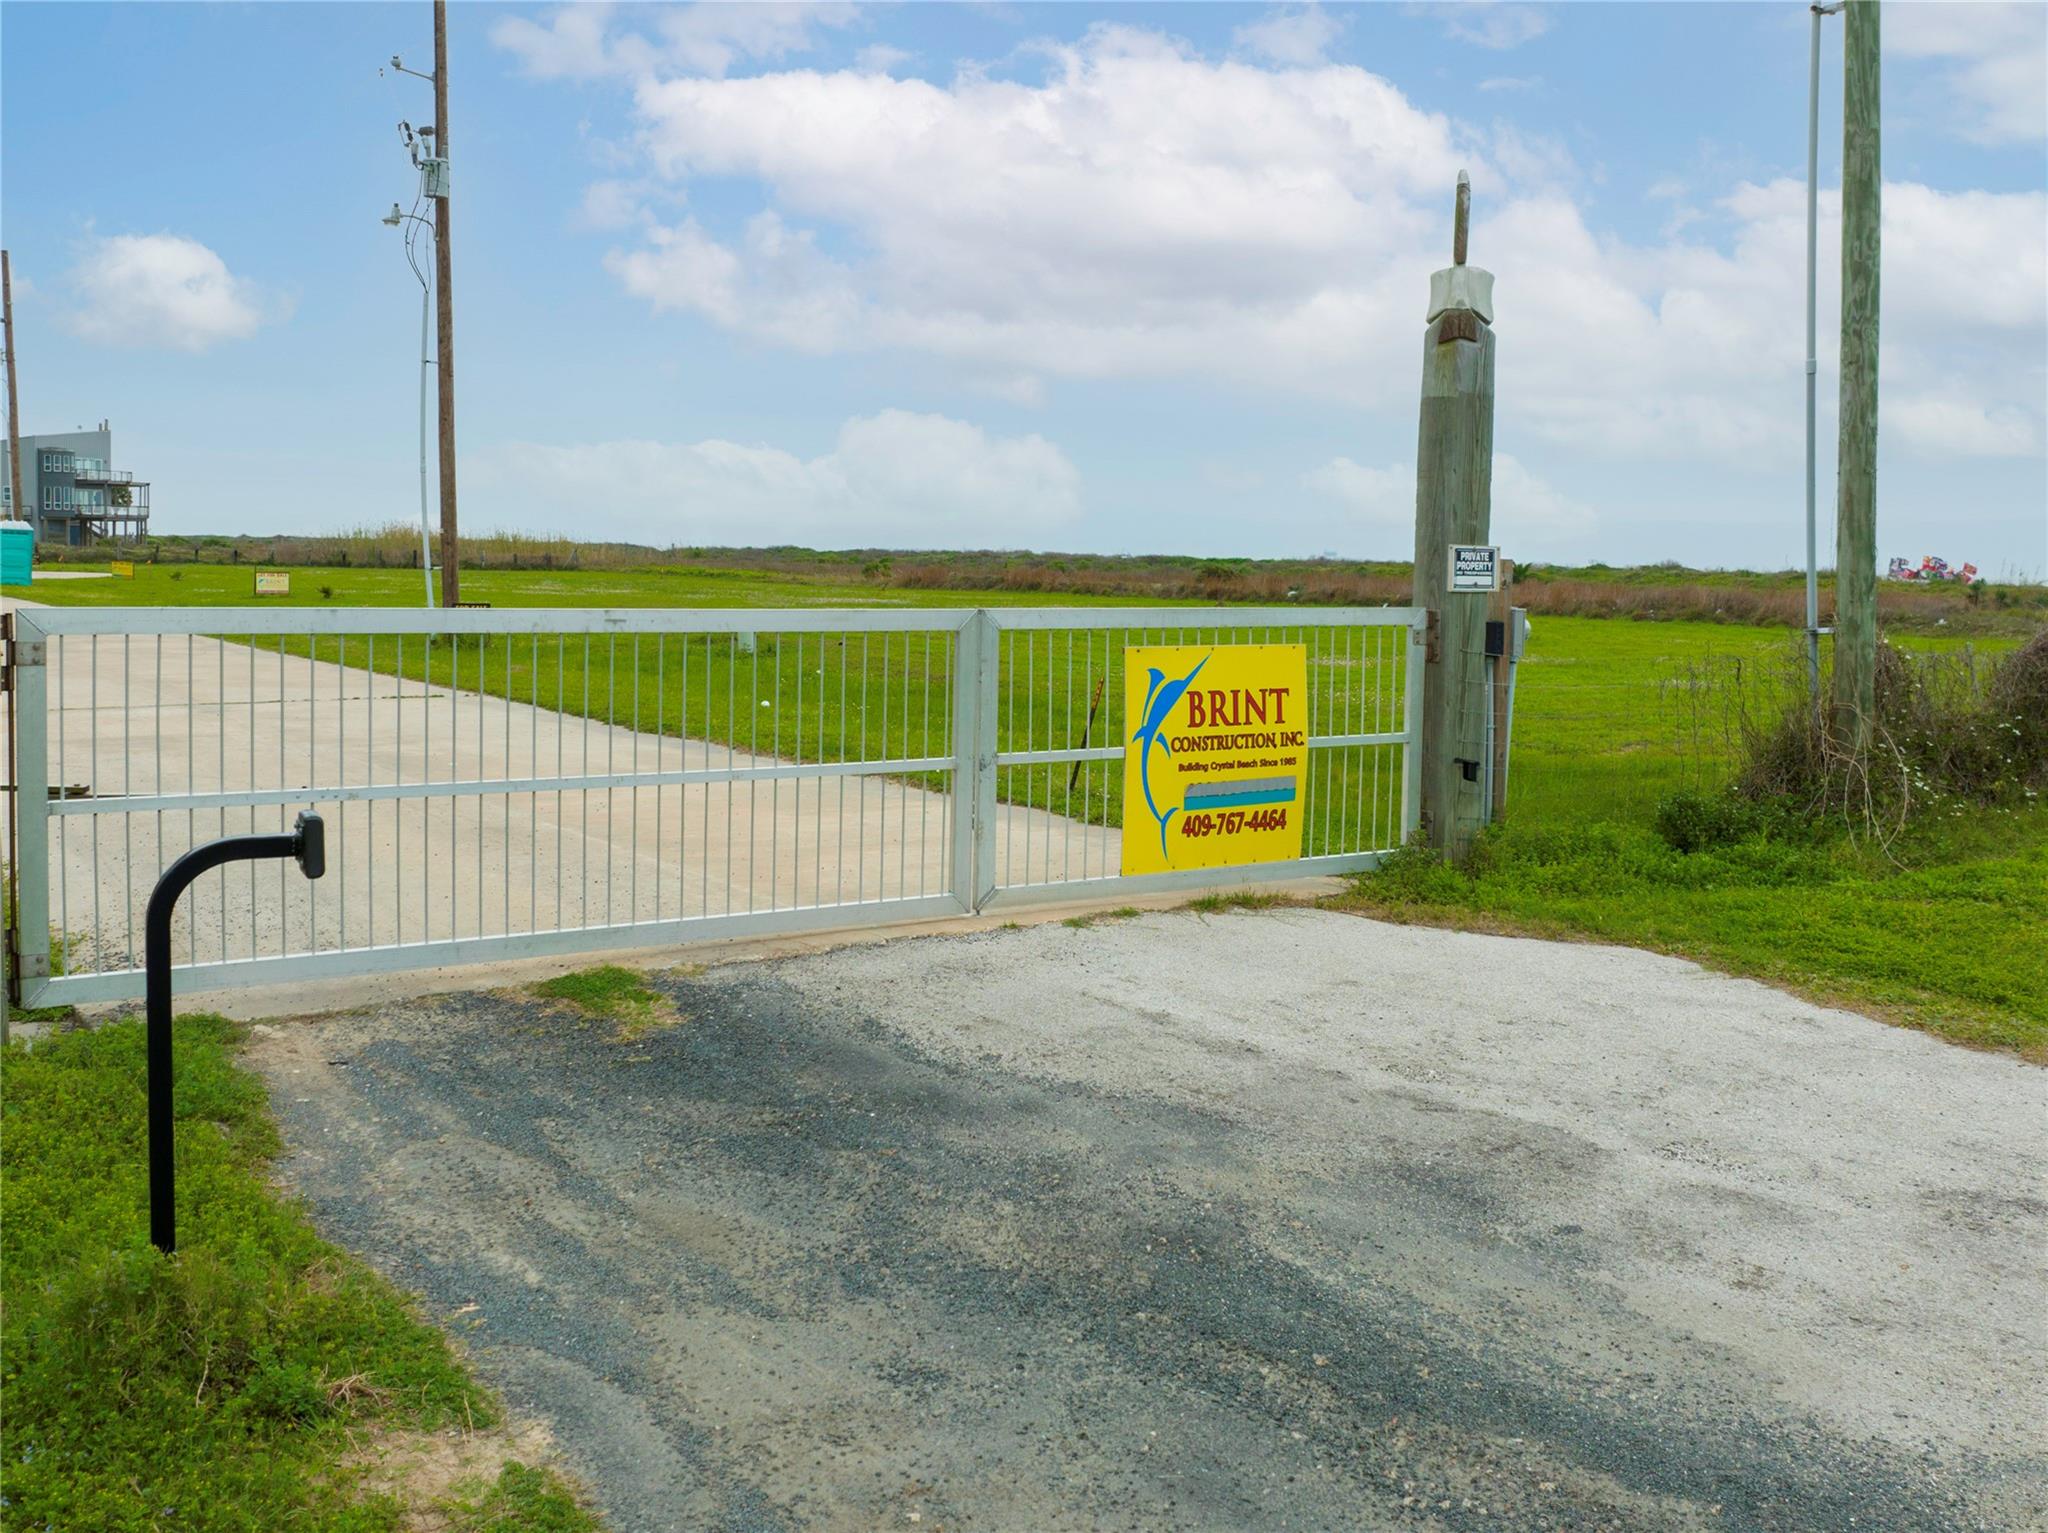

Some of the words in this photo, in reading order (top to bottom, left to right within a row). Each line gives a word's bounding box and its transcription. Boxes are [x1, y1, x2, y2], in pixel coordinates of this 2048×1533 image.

[1460, 551, 1490, 561] PRIVATE
[1456, 561, 1493, 571] PROPERTY
[1187, 687, 1290, 728] BRINT
[1280, 731, 1305, 747] INC.
[1178, 762, 1209, 773] Building
[1210, 760, 1235, 772] Crystal
[1237, 759, 1258, 769] Beach
[1259, 758, 1278, 768] Since
[1181, 808, 1287, 838] 409-767-4464
